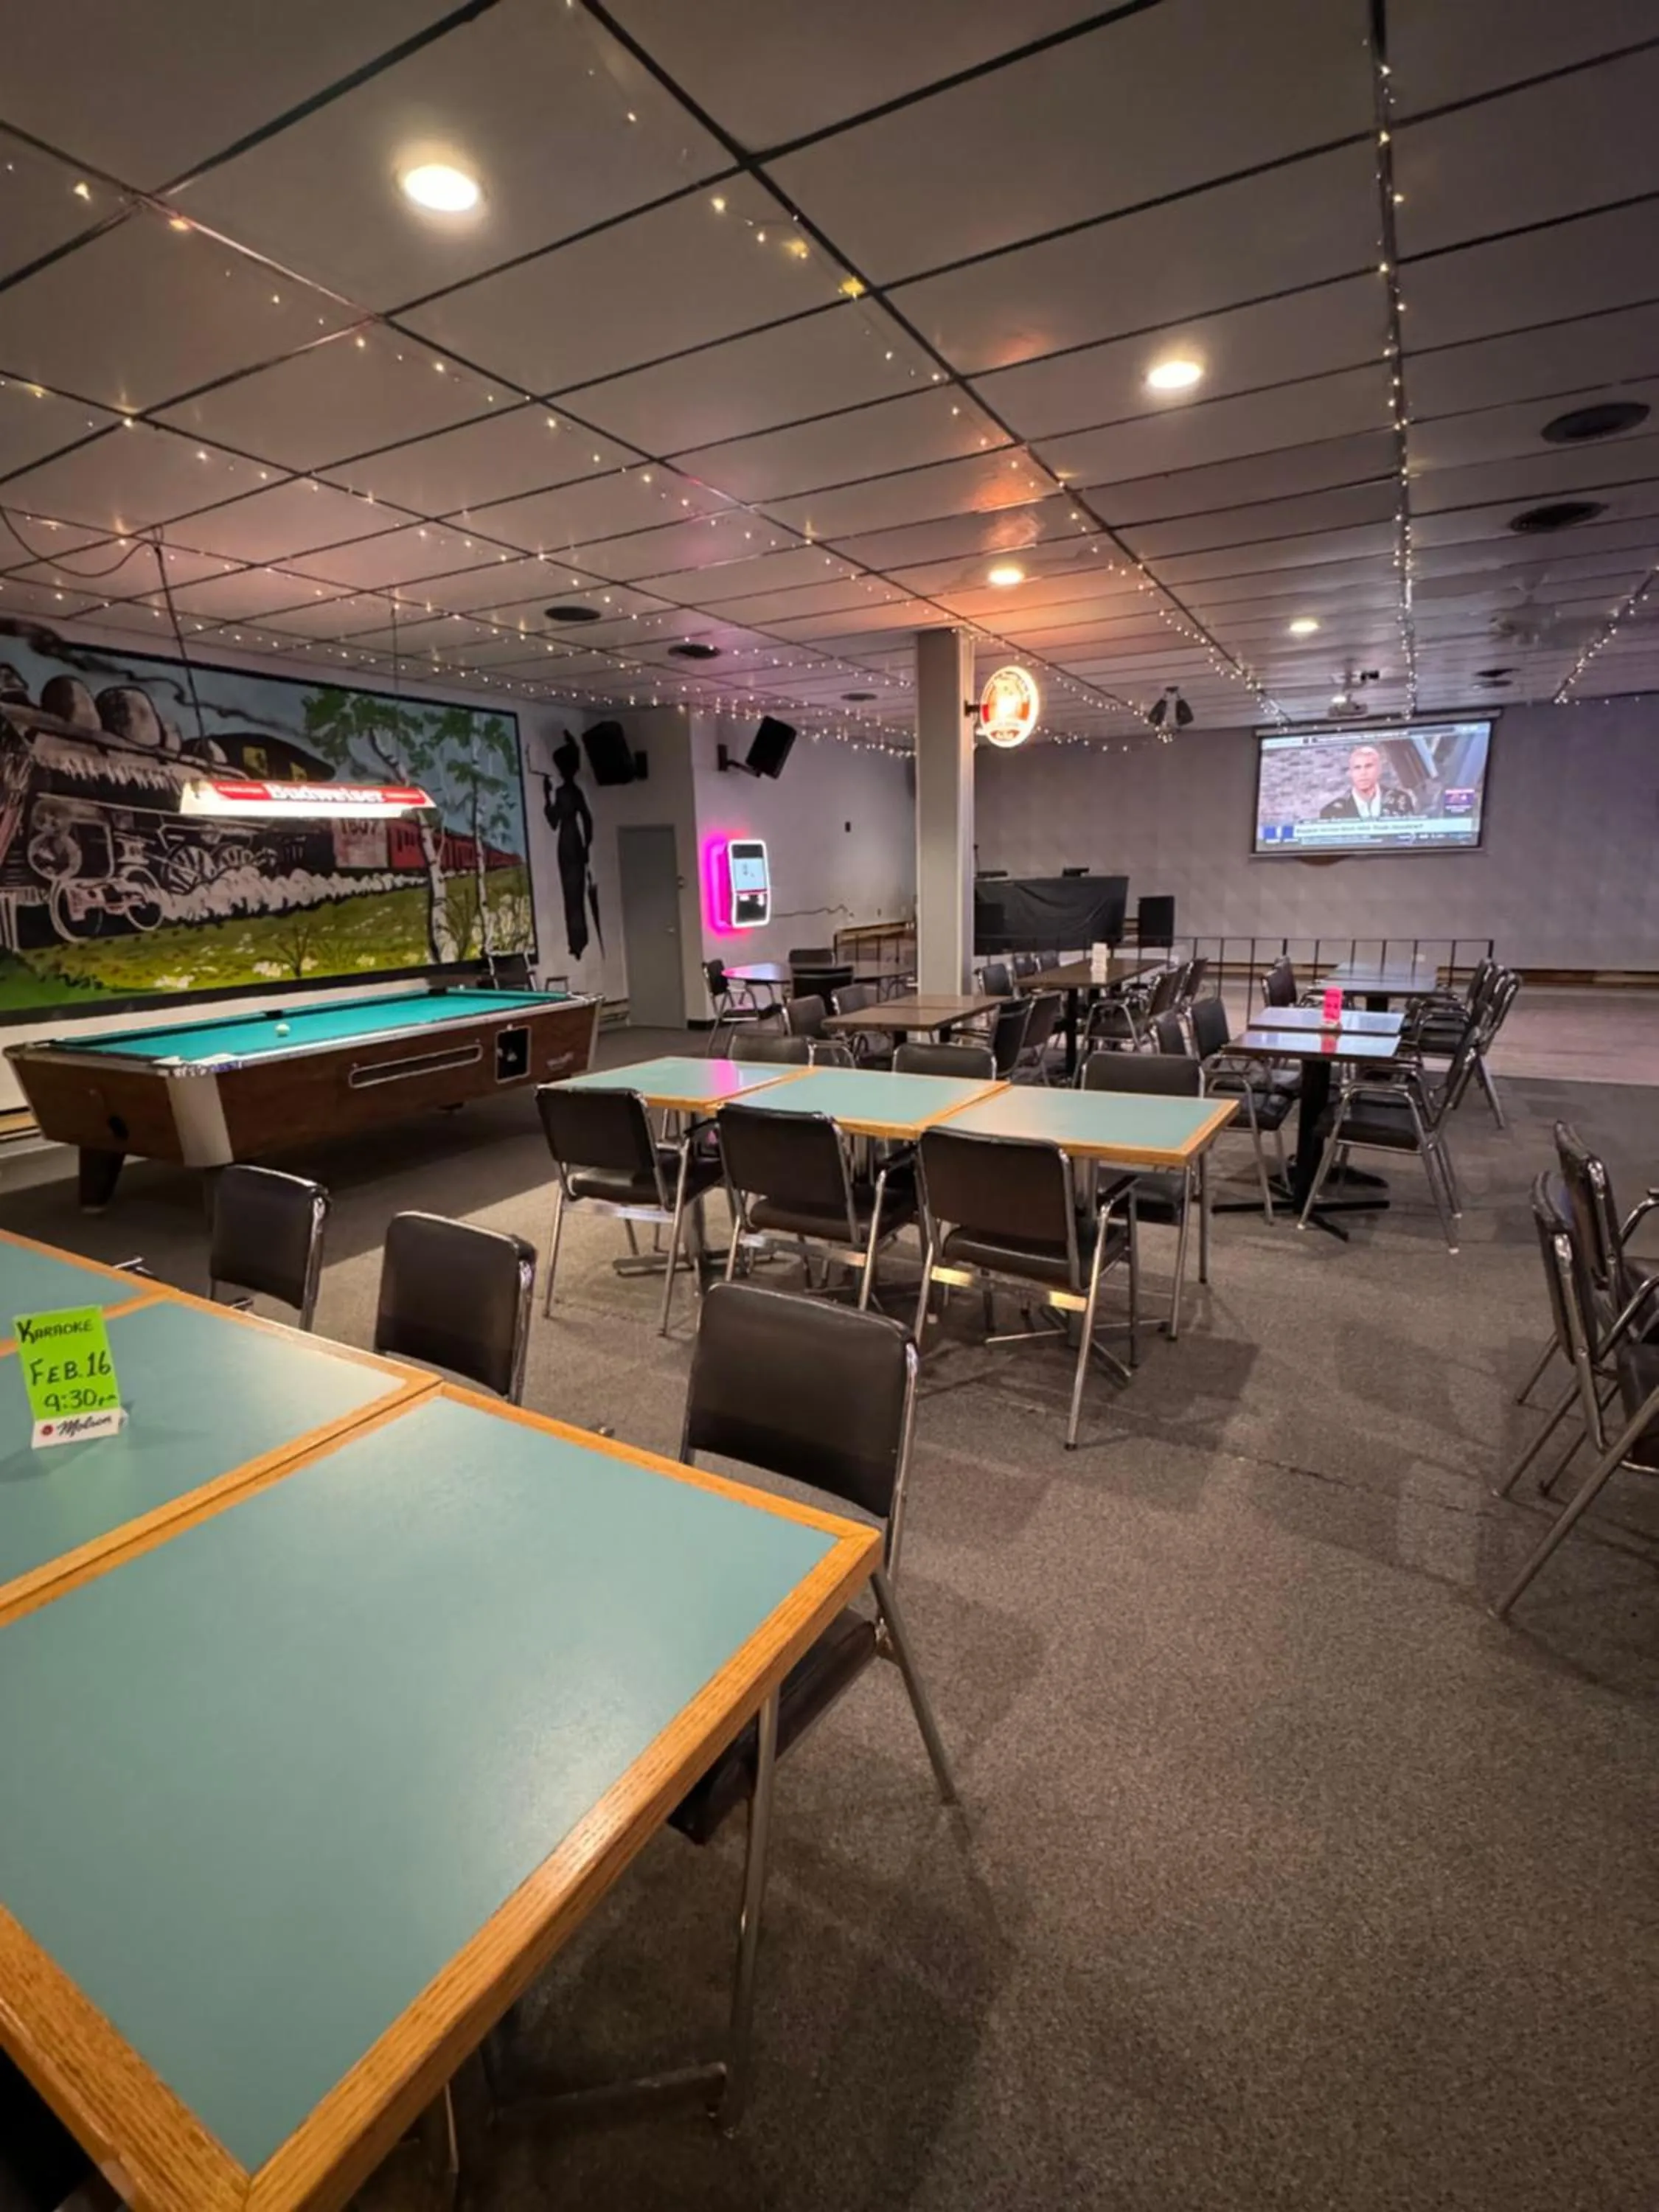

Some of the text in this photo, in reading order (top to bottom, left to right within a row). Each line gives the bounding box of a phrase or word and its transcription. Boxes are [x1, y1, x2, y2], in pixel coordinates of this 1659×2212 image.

[263, 782, 383, 802] Budweiser
[16, 1318, 94, 1344] KARAOKE
[57, 1415, 112, 1438] Molson
